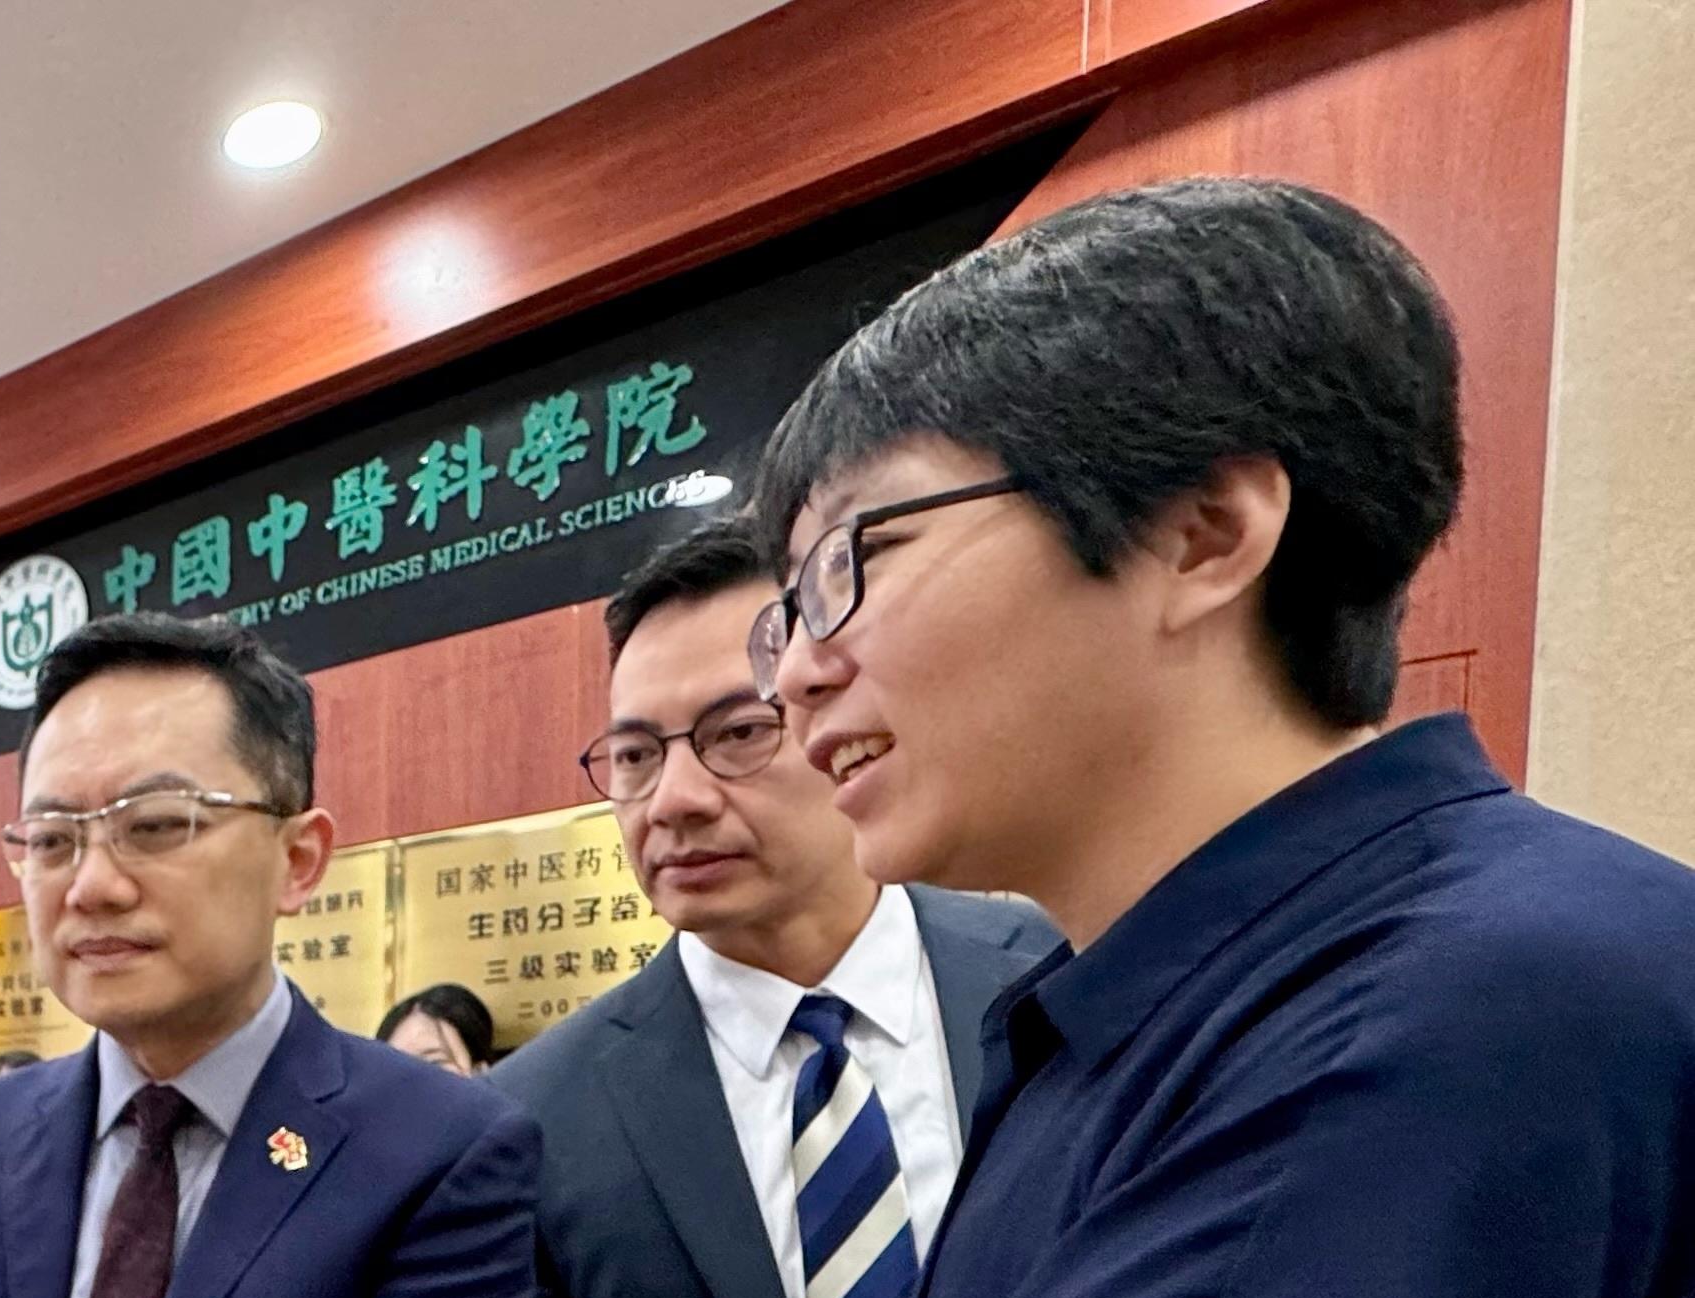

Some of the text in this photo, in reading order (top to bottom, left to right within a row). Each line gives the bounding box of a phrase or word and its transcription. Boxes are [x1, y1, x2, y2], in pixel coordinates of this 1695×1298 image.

[104, 361, 706, 609] 中國中醫科學院
[279, 587, 311, 616] OF
[316, 554, 425, 605] CHINESE
[430, 517, 553, 574] MEDICAL
[468, 892, 661, 941] 生药分子鉴
[484, 943, 657, 985] 三级实验室
